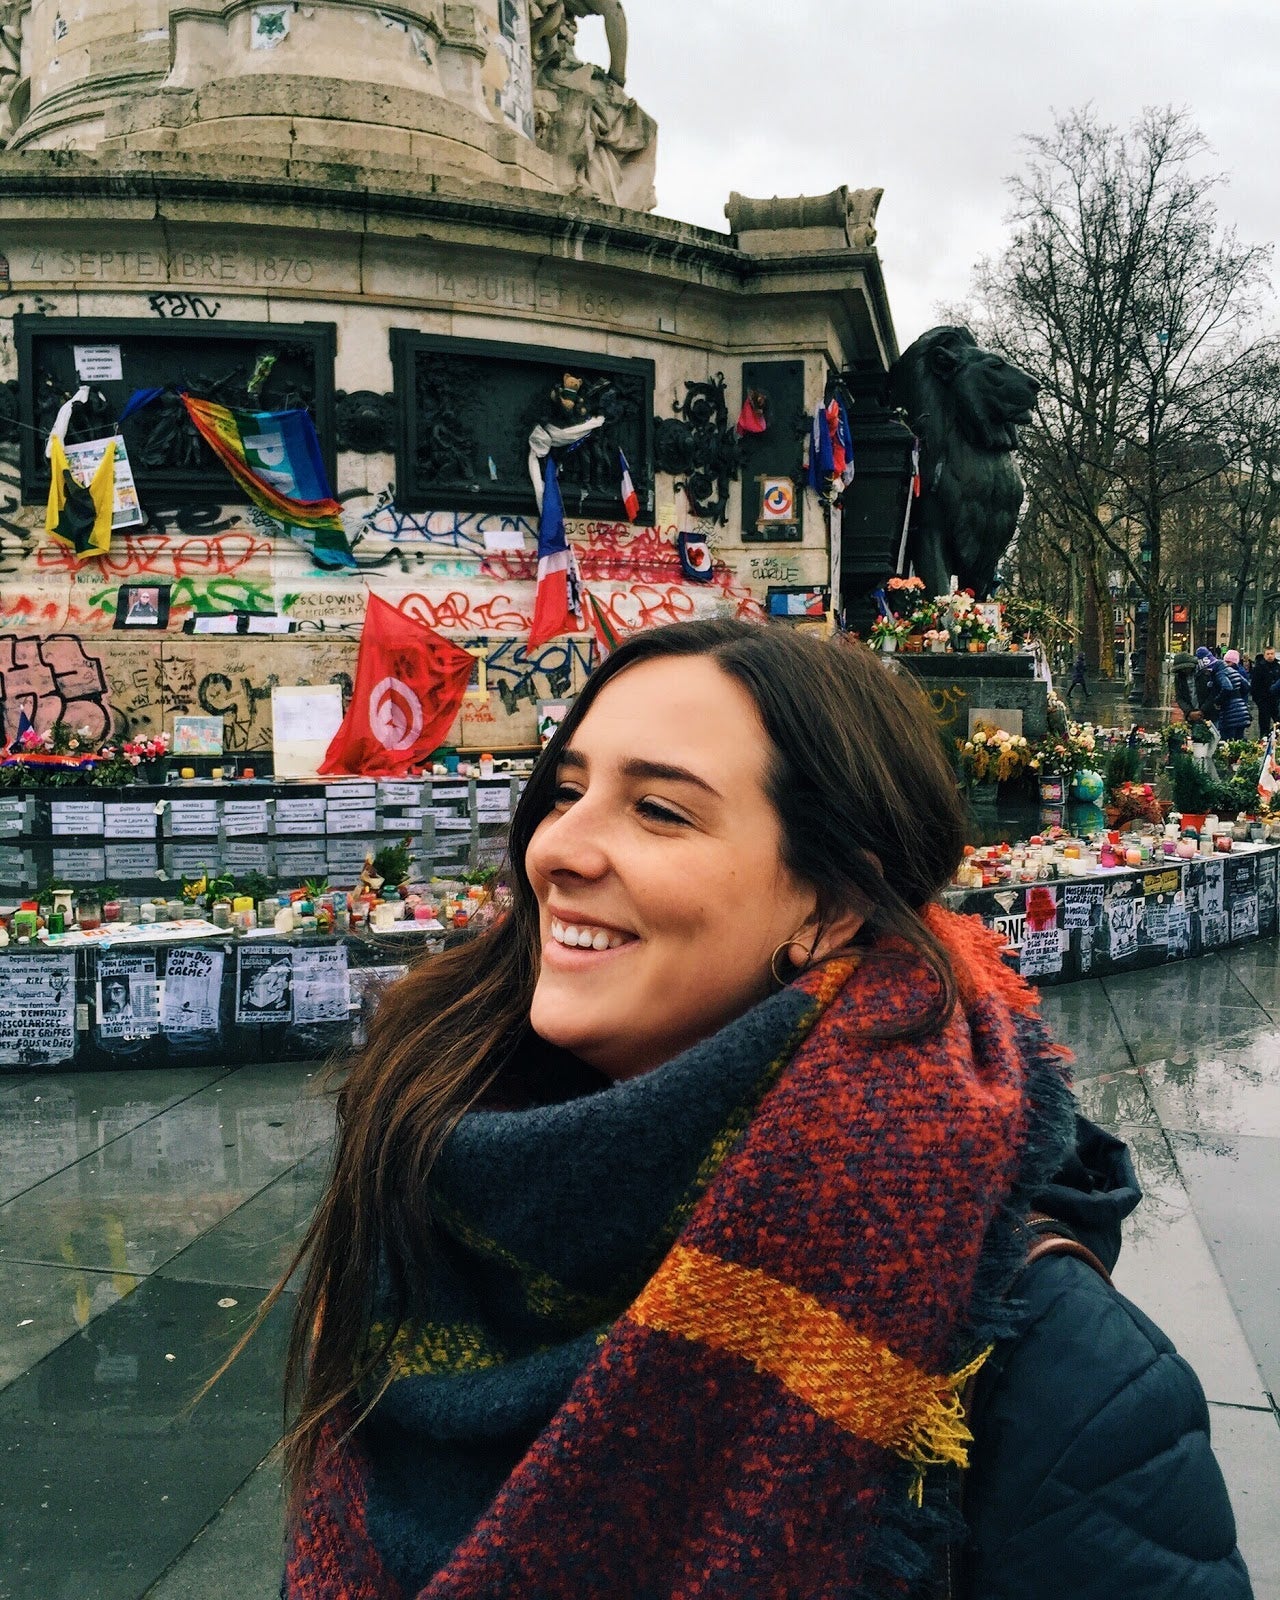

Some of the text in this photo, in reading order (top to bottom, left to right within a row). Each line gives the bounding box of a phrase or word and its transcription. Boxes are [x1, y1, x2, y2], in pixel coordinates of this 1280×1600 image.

[30, 251, 314, 283] 4 SEPTEMBRE 1870
[435, 271, 456, 297] 14
[466, 275, 569, 313] JUILLET
[22, 1029, 35, 1038] LES
